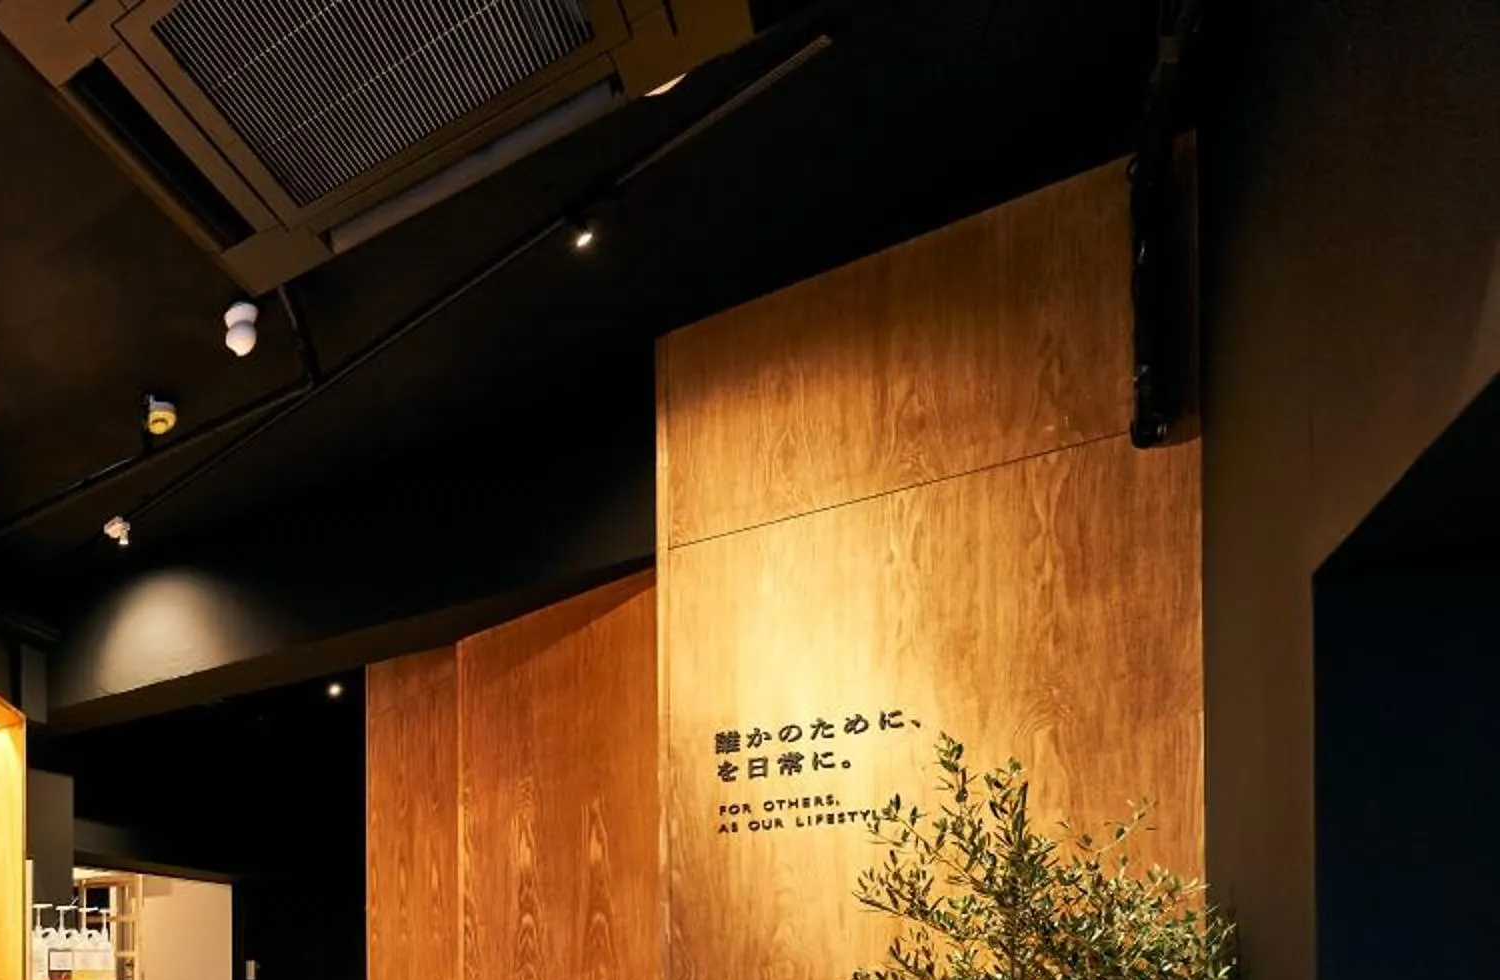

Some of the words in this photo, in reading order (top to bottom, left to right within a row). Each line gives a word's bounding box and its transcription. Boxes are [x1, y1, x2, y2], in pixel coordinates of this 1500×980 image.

[717, 751, 851, 782] を日常に。
[719, 803, 751, 816] FOR
[718, 821, 738, 834] AS
[748, 817, 784, 832] OUR
